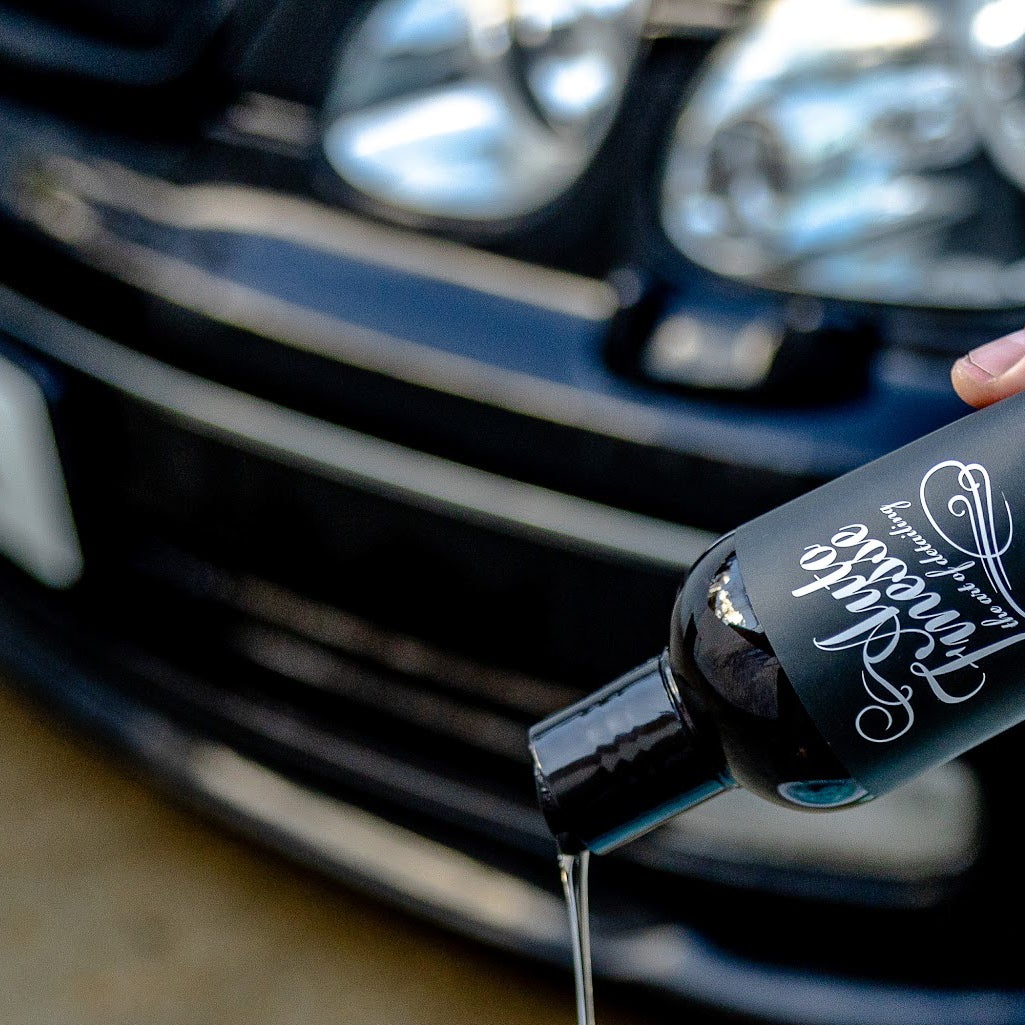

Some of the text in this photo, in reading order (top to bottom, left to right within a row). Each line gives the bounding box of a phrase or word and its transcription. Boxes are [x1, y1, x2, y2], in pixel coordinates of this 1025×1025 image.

[792, 544, 935, 742] Auto
[879, 500, 1019, 629] the art of detailing
